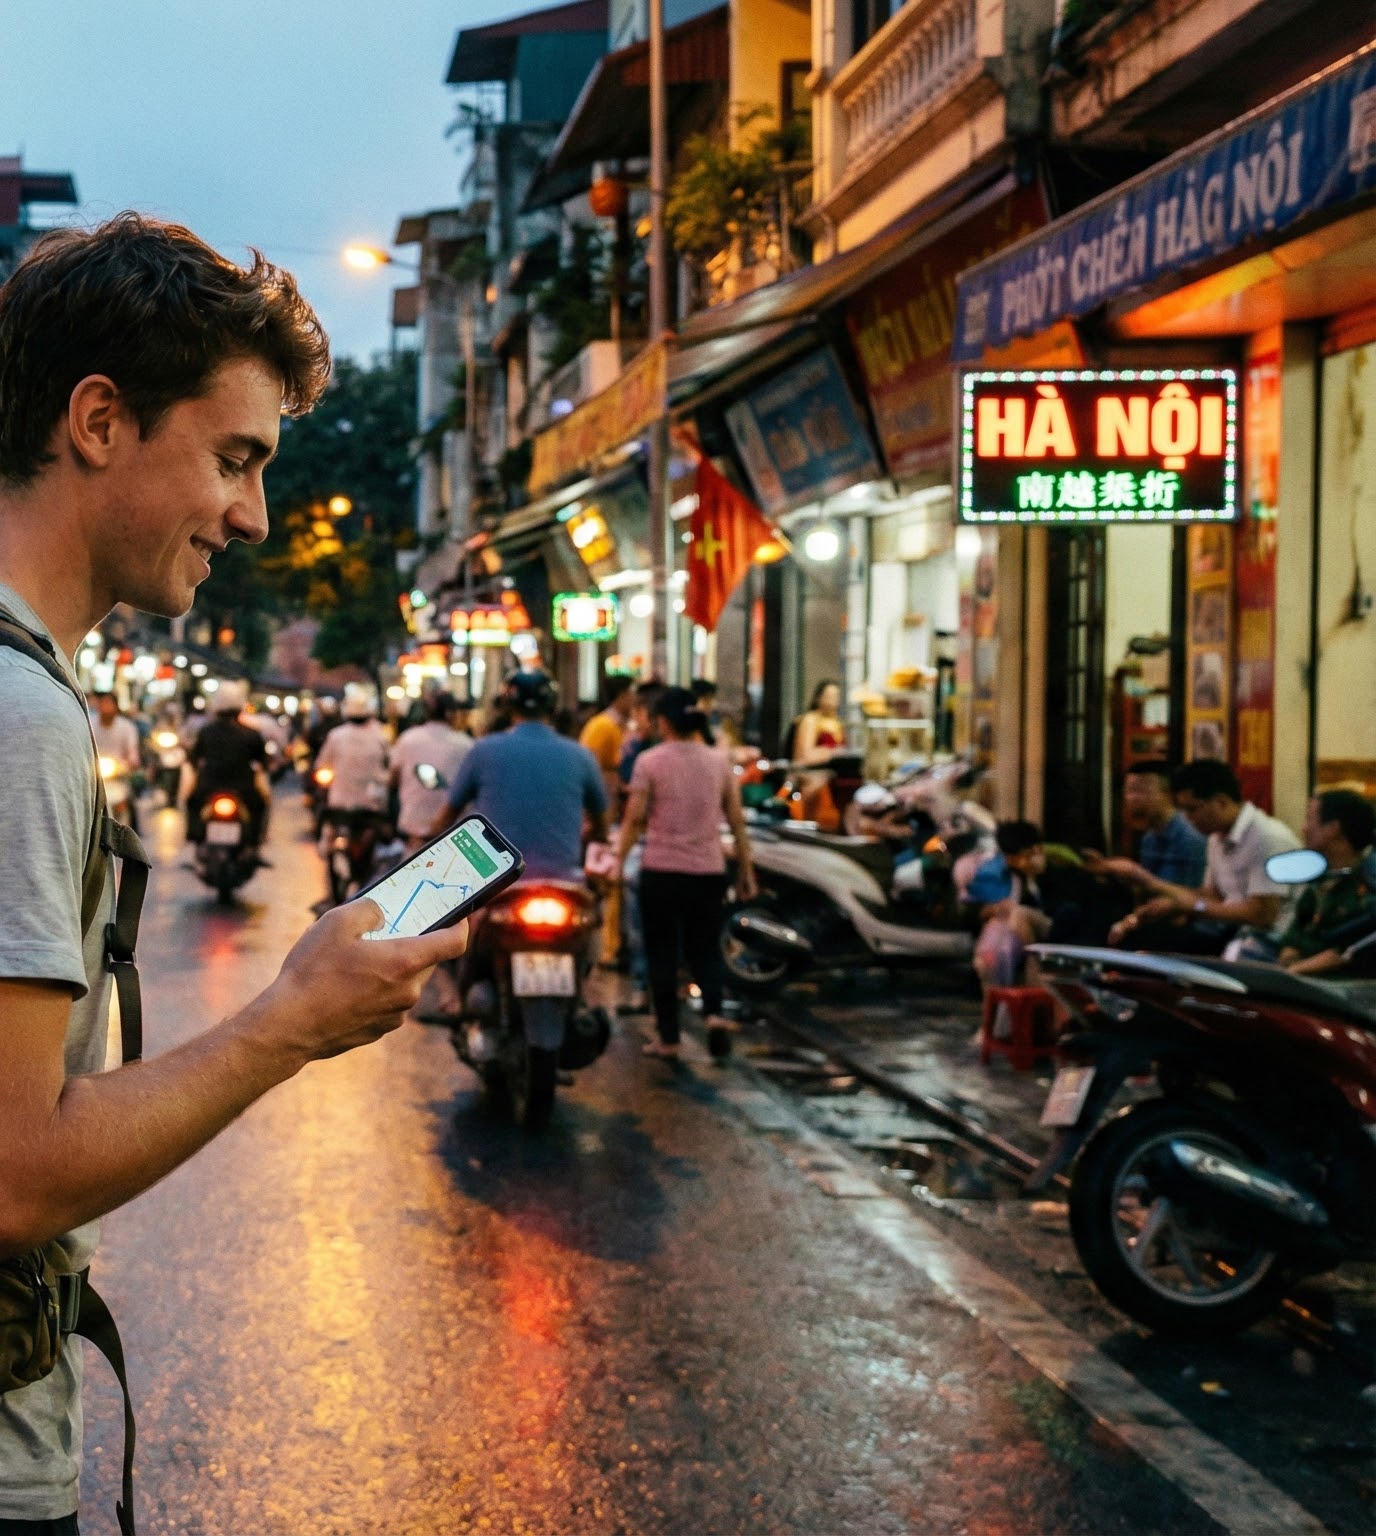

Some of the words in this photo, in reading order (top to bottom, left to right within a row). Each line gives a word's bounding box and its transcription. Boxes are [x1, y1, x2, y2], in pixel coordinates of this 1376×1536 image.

[1230, 119, 1304, 232] NỘI
[977, 384, 1077, 458] HÀ
[1096, 382, 1223, 470] NỘI
